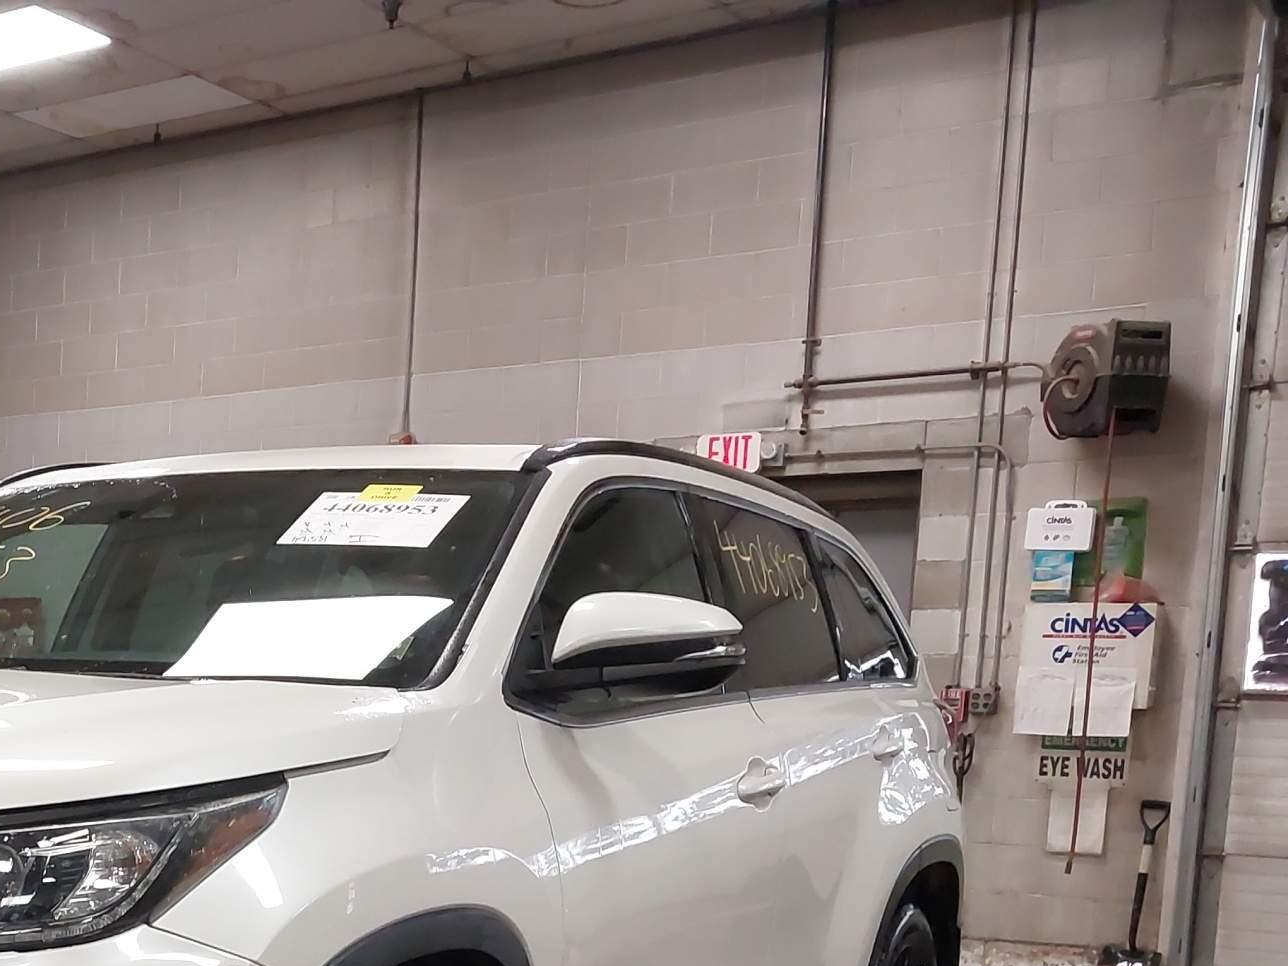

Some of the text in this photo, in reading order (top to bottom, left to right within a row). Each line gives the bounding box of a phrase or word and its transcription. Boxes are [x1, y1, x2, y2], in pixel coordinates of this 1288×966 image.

[708, 434, 753, 470] EXIT
[322, 502, 440, 516] 44068953
[1039, 755, 1125, 780] EYE WASH
